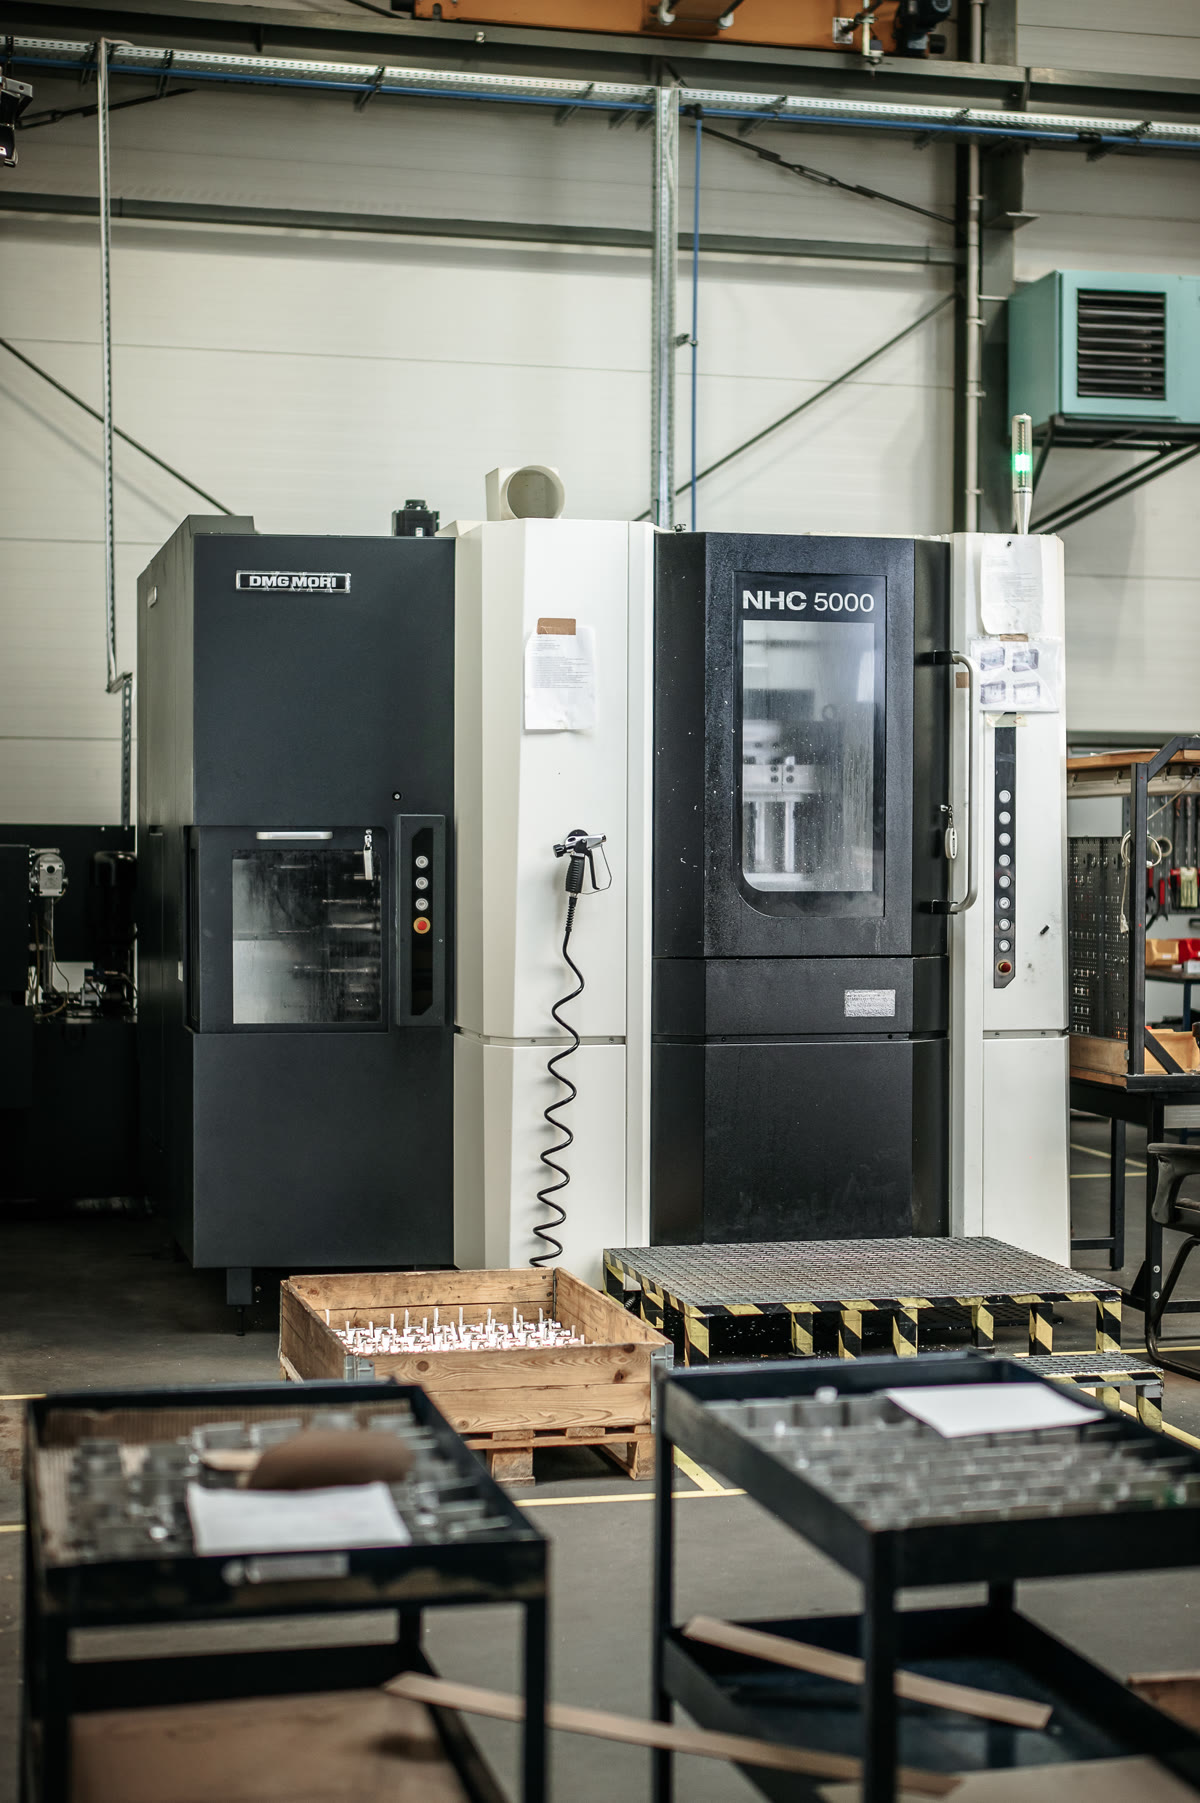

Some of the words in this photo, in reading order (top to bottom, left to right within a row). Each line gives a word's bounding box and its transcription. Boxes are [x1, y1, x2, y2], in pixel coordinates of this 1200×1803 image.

[249, 575, 289, 587] DMG
[292, 577, 337, 588] MORI
[742, 590, 807, 611] NHC
[813, 592, 875, 613] 5000
